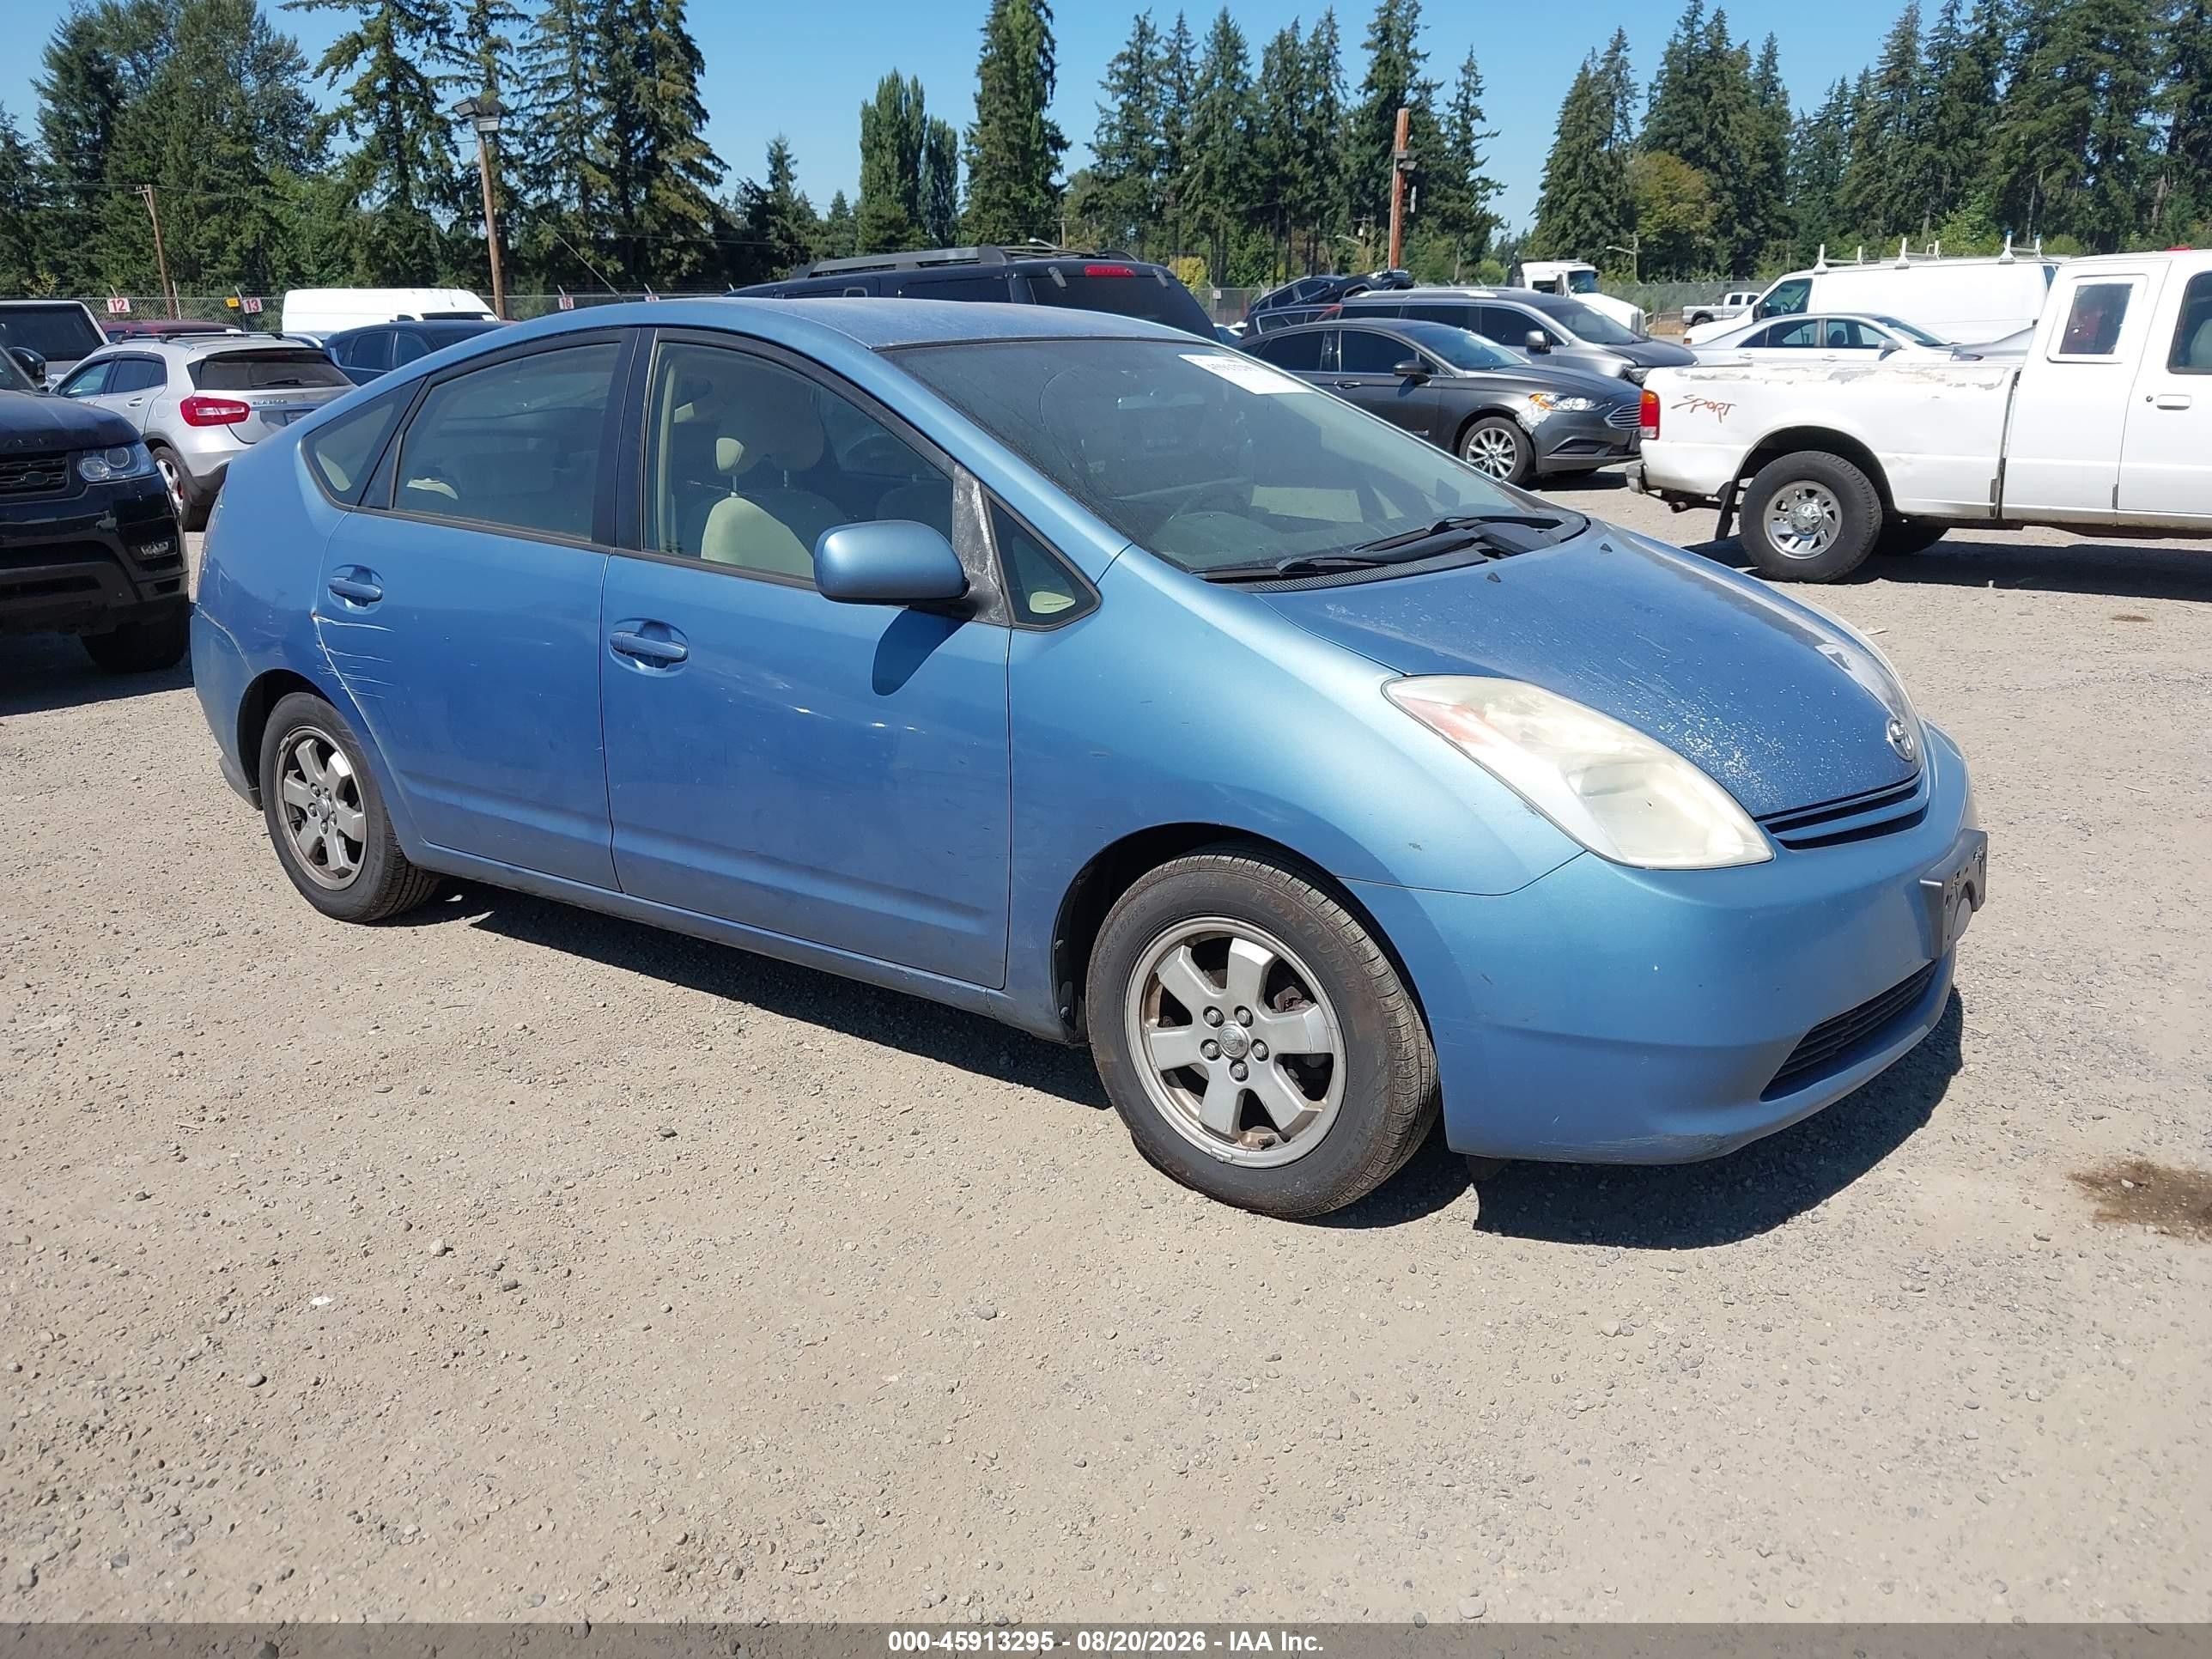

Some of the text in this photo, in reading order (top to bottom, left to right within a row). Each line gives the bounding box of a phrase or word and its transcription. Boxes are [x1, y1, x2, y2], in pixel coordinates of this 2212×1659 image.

[111, 299, 127, 312] 12
[246, 300, 259, 312] 13
[1670, 394, 1737, 423] SPORT
